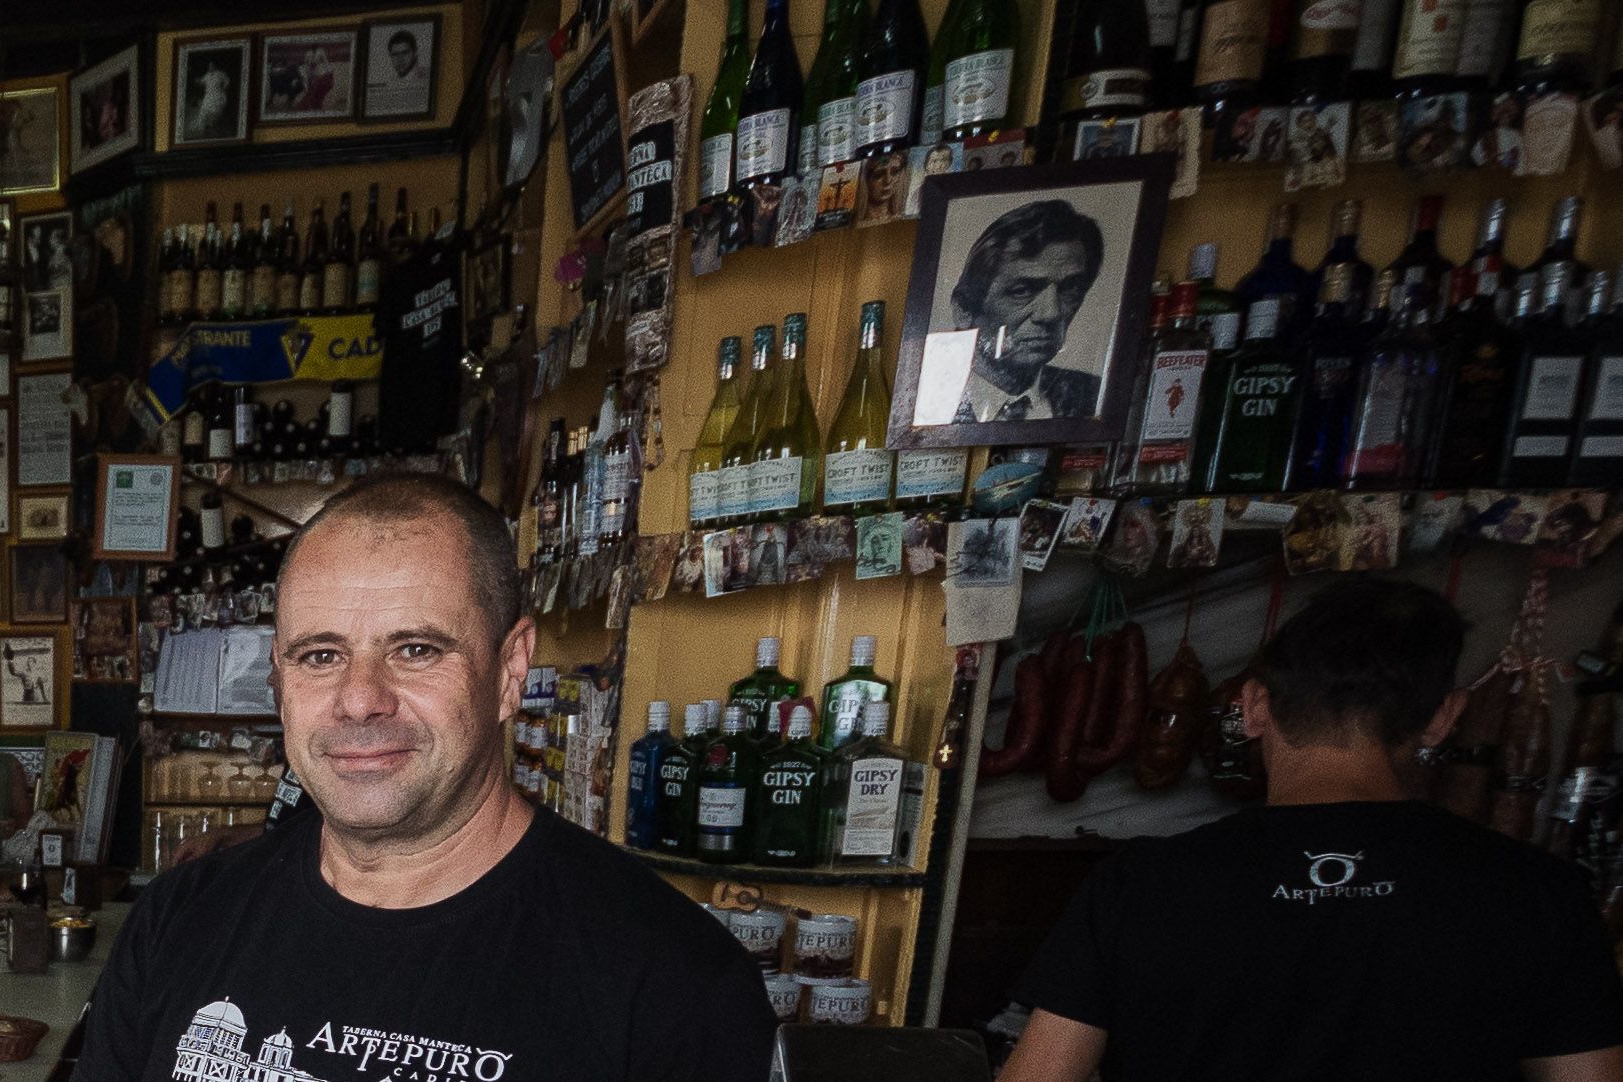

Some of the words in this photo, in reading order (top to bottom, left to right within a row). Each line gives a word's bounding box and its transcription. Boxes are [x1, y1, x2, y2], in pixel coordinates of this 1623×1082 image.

[1156, 355, 1206, 369] BEEFEATER
[1233, 376, 1295, 395] GIPSY
[1241, 398, 1276, 417] GIN
[661, 764, 690, 781] GIPSY
[763, 771, 817, 788] GIPSY
[854, 769, 899, 784] GIPSY
[665, 781, 682, 797] GIN
[772, 789, 802, 805] GIN
[861, 783, 888, 797] DRY
[1272, 881, 1397, 905] ARTEPURO
[342, 1025, 387, 1039] TABERNA
[389, 1032, 416, 1044] CASA
[418, 1036, 473, 1055] MANTECA
[306, 1021, 511, 1082] ARTEPURO
